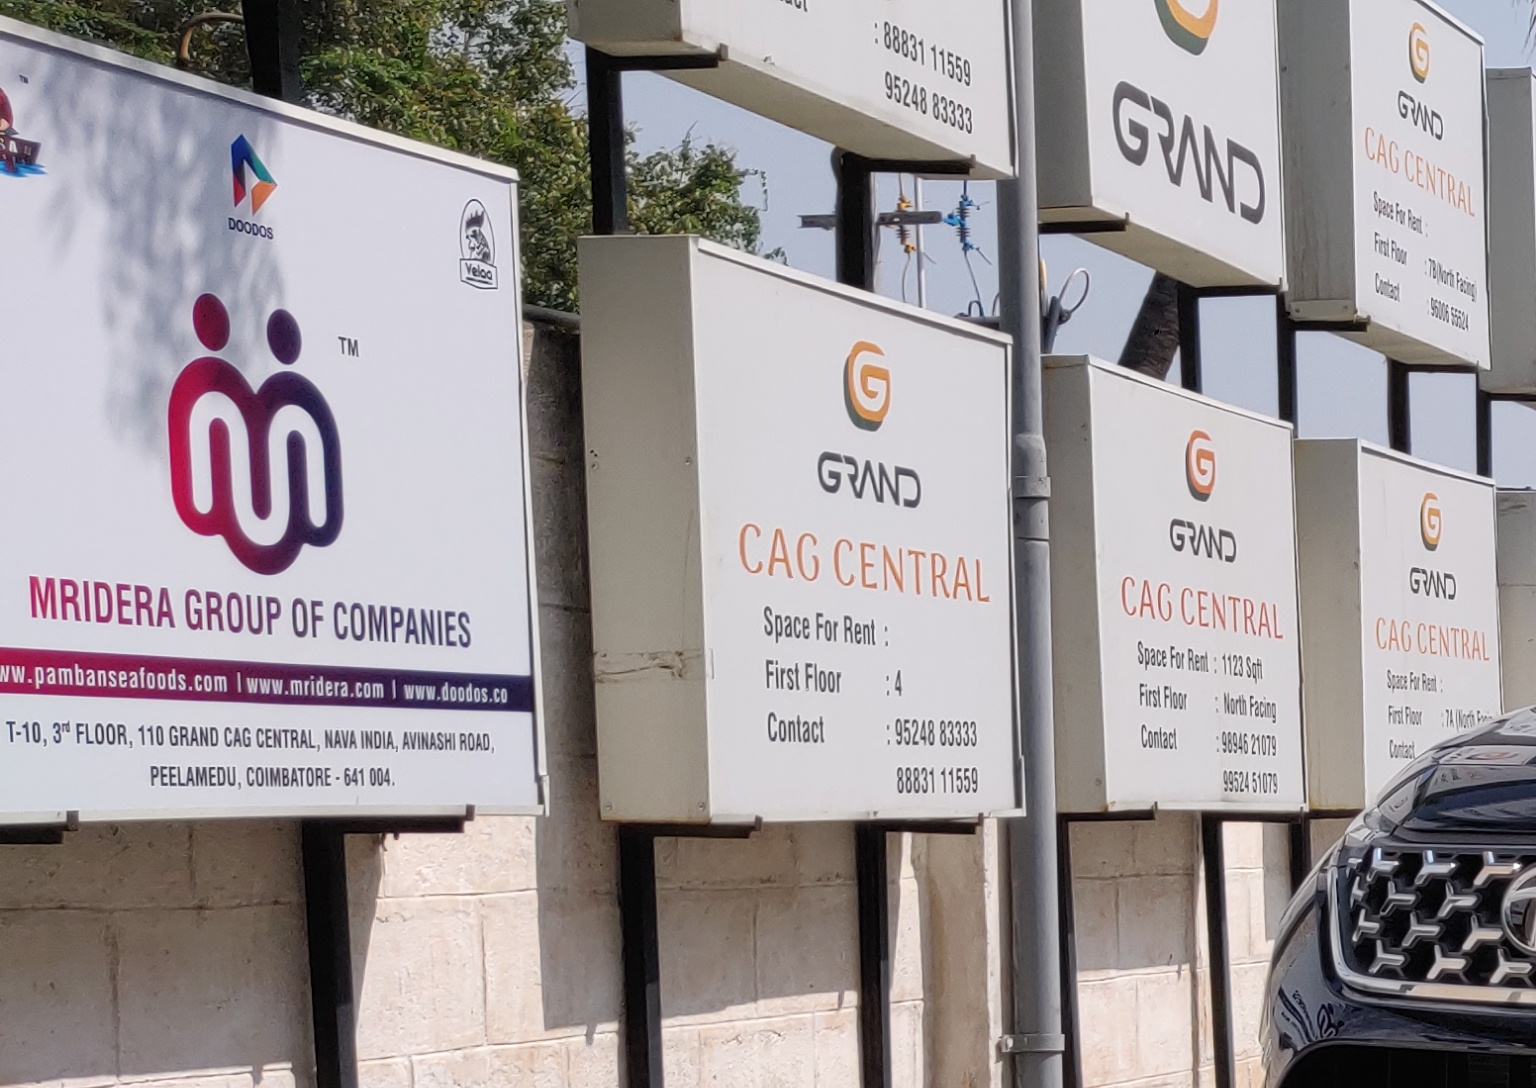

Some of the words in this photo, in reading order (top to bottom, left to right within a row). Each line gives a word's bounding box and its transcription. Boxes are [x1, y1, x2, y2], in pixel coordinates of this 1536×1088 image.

[884, 21, 926, 66] 88831
[930, 44, 972, 87] 11559
[885, 71, 928, 115] 95248
[932, 93, 973, 135] 83333
[1398, 90, 1444, 141] GRAND
[1112, 81, 1266, 225] GRAND
[1365, 127, 1400, 174] CAG
[1404, 149, 1476, 217] CENTRAL
[228, 217, 274, 241] DOODOS
[1373, 190, 1394, 220] Space
[1395, 203, 1406, 227] For
[1408, 209, 1423, 235] Rent
[1374, 232, 1390, 258] First
[1391, 240, 1407, 266] Floor
[1375, 272, 1400, 302] Contact
[338, 336, 359, 358] TM
[818, 450, 922, 509] GRAND
[1170, 518, 1237, 564] GRAND
[739, 523, 821, 582] CAG
[834, 539, 991, 603] CENTRAL
[1409, 567, 1457, 600] GRAND
[29, 575, 176, 628] MRIDERA
[185, 589, 281, 635] GROUP
[291, 597, 324, 639] OF
[333, 602, 472, 648] COMPANIES
[763, 606, 810, 644] Space
[816, 613, 839, 643] For
[844, 616, 876, 646] Rent
[1121, 576, 1173, 622] CAG
[1181, 587, 1284, 641] CENTRAL
[1376, 617, 1412, 652] CAG
[1417, 623, 1490, 661] CENTRAL
[766, 659, 800, 692] First
[805, 663, 842, 694] Floor
[894, 670, 903, 697] 4
[1137, 641, 1167, 673] Space
[1170, 645, 1186, 671] For
[1188, 648, 1209, 673] Rent
[1222, 654, 1244, 679] 1123
[1246, 656, 1263, 685] Sqft
[1387, 669, 1408, 694] Space
[1409, 672, 1420, 691] For
[1421, 673, 1437, 692] Rent
[246, 675, 384, 699] www.mridera.com
[404, 682, 508, 704] www.doodos.co
[1139, 683, 1162, 709] First
[1164, 685, 1188, 711] Floor
[1223, 696, 1247, 720] North
[1249, 698, 1277, 725] Facing
[767, 712, 825, 744] Contact
[895, 718, 936, 747] 95248
[940, 720, 978, 748] 83333
[1388, 705, 1404, 725] First
[1405, 706, 1422, 726] Floor
[1445, 709, 1454, 728] 7A
[6, 720, 47, 747] T-10,
[52, 720, 71, 744] 3rd
[76, 722, 133, 749] FLOOR,
[138, 725, 164, 746] 110
[169, 725, 219, 747] GRAND
[224, 727, 252, 748] CAG
[256, 728, 321, 752] CENTRAL,
[325, 729, 358, 750] NAVA
[361, 730, 398, 753] INDIA,
[402, 731, 456, 751] AVINASHI
[460, 732, 495, 754] ROAD,
[1141, 724, 1177, 751] Contact
[1222, 731, 1249, 755] 98946
[1251, 733, 1277, 757] 21079
[1389, 739, 1415, 760] Contact
[150, 765, 242, 790] PEELAMEDU,
[246, 766, 332, 787] COIMBATORE
[344, 767, 365, 788] 641
[369, 768, 395, 787] 004.
[897, 767, 936, 794] 88831
[941, 767, 979, 794] 11559
[1223, 769, 1250, 794] 99524
[1252, 770, 1278, 794] 51079
